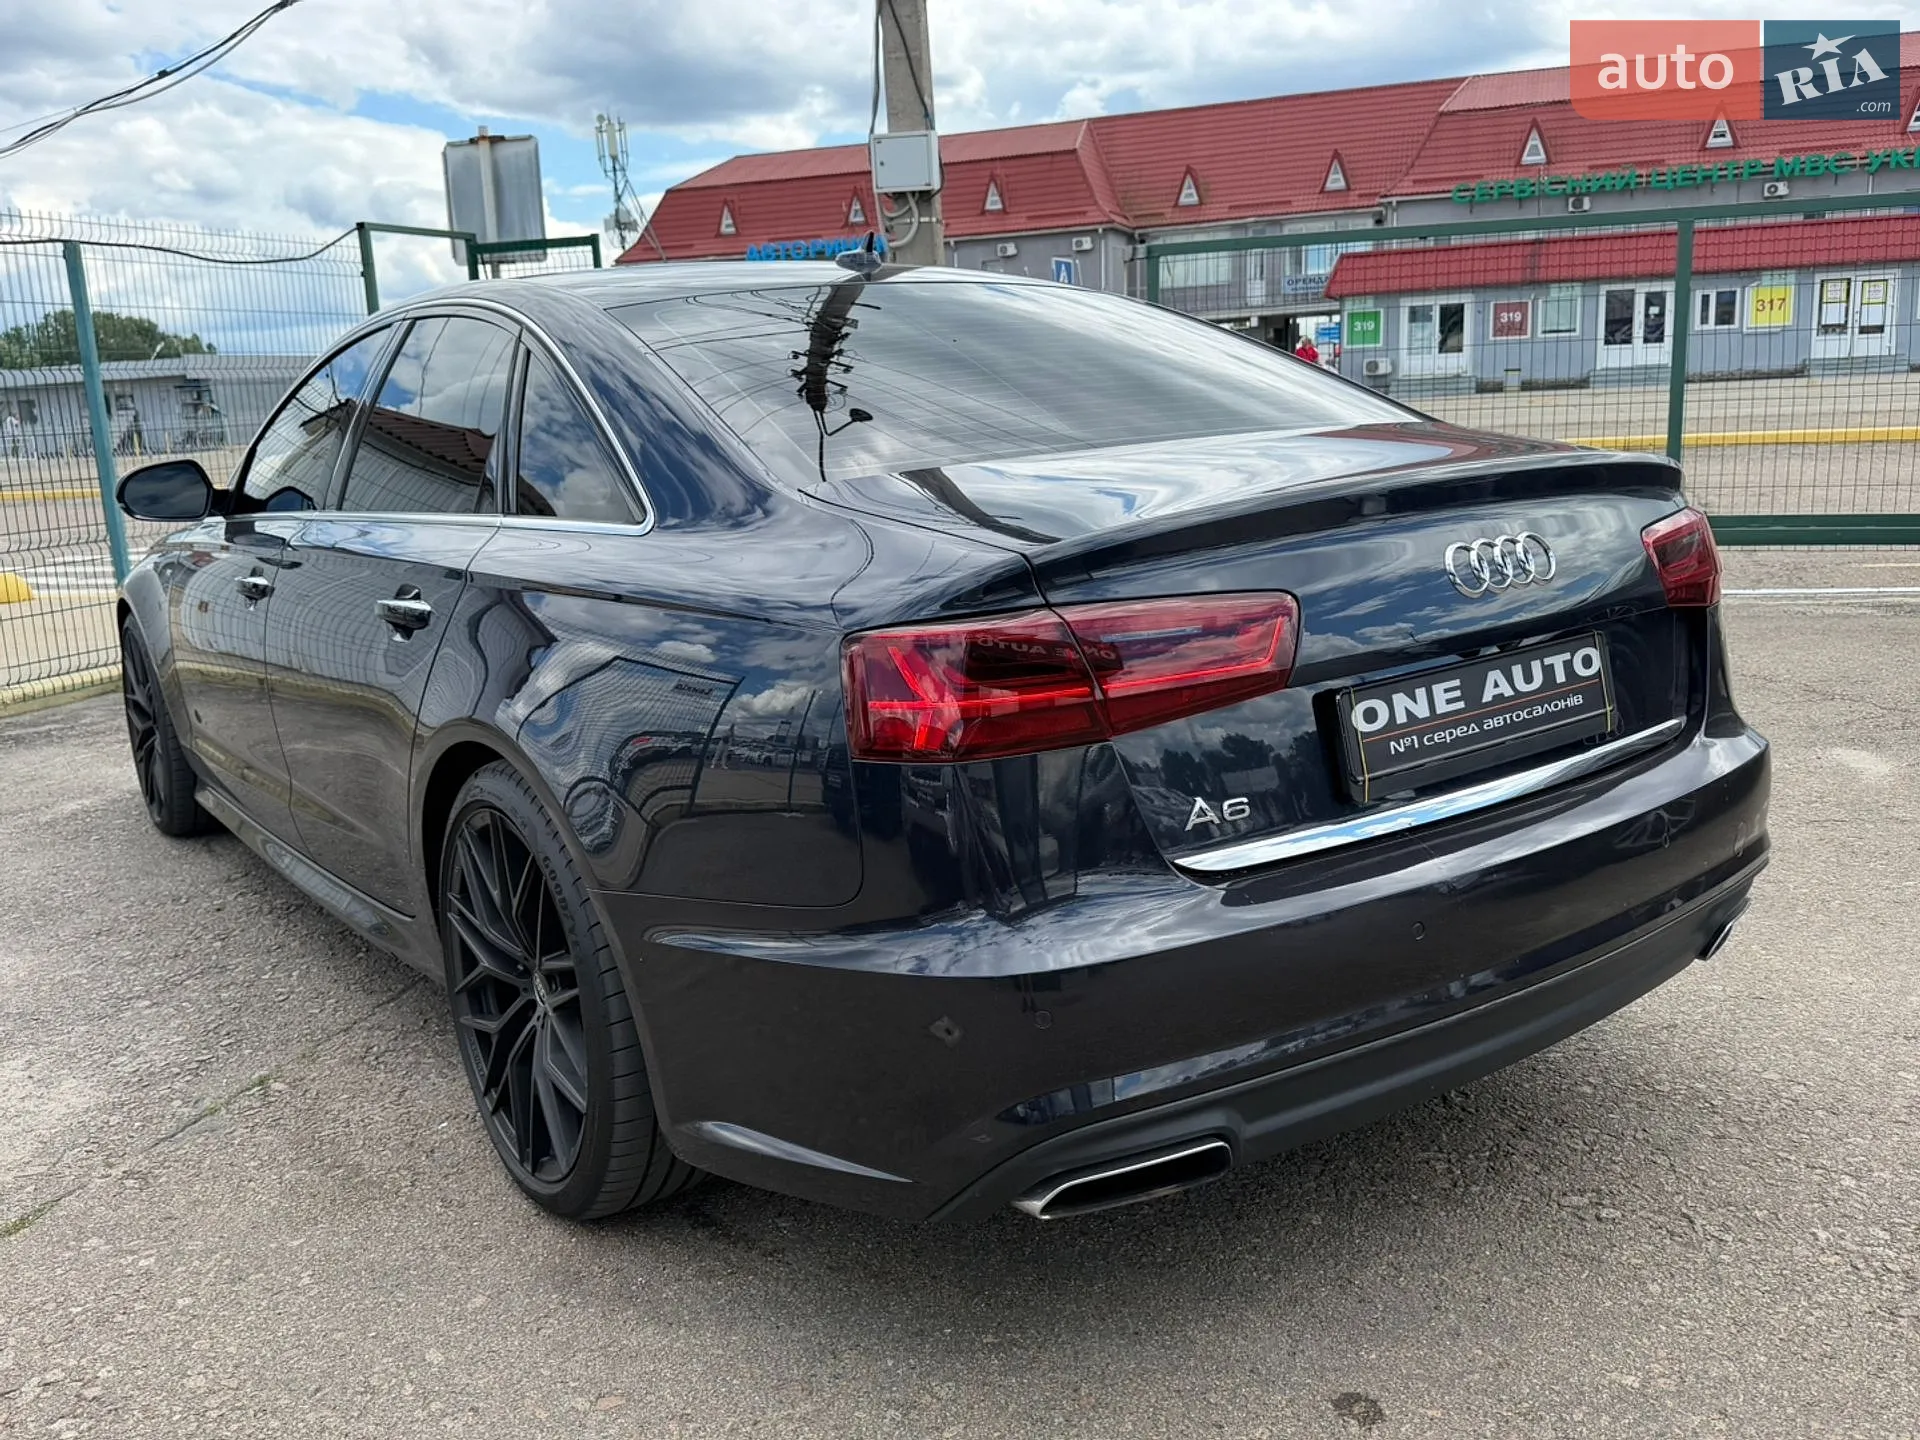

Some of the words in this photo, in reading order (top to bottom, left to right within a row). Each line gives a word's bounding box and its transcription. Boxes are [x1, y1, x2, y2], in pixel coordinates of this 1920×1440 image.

[1452, 164, 1637, 204] СЕРВІСНИЙ
[1650, 159, 1762, 190] ЦЕНТР
[1773, 152, 1853, 178] МВС
[1500, 311, 1521, 323] 319
[1756, 298, 1785, 312] 317
[1354, 320, 1375, 331] 319
[1351, 679, 1466, 732] ONE
[1482, 647, 1600, 703] AUTO
[1423, 723, 1480, 743] серед
[1483, 694, 1583, 730] автосалонів
[1184, 797, 1250, 831] A6
